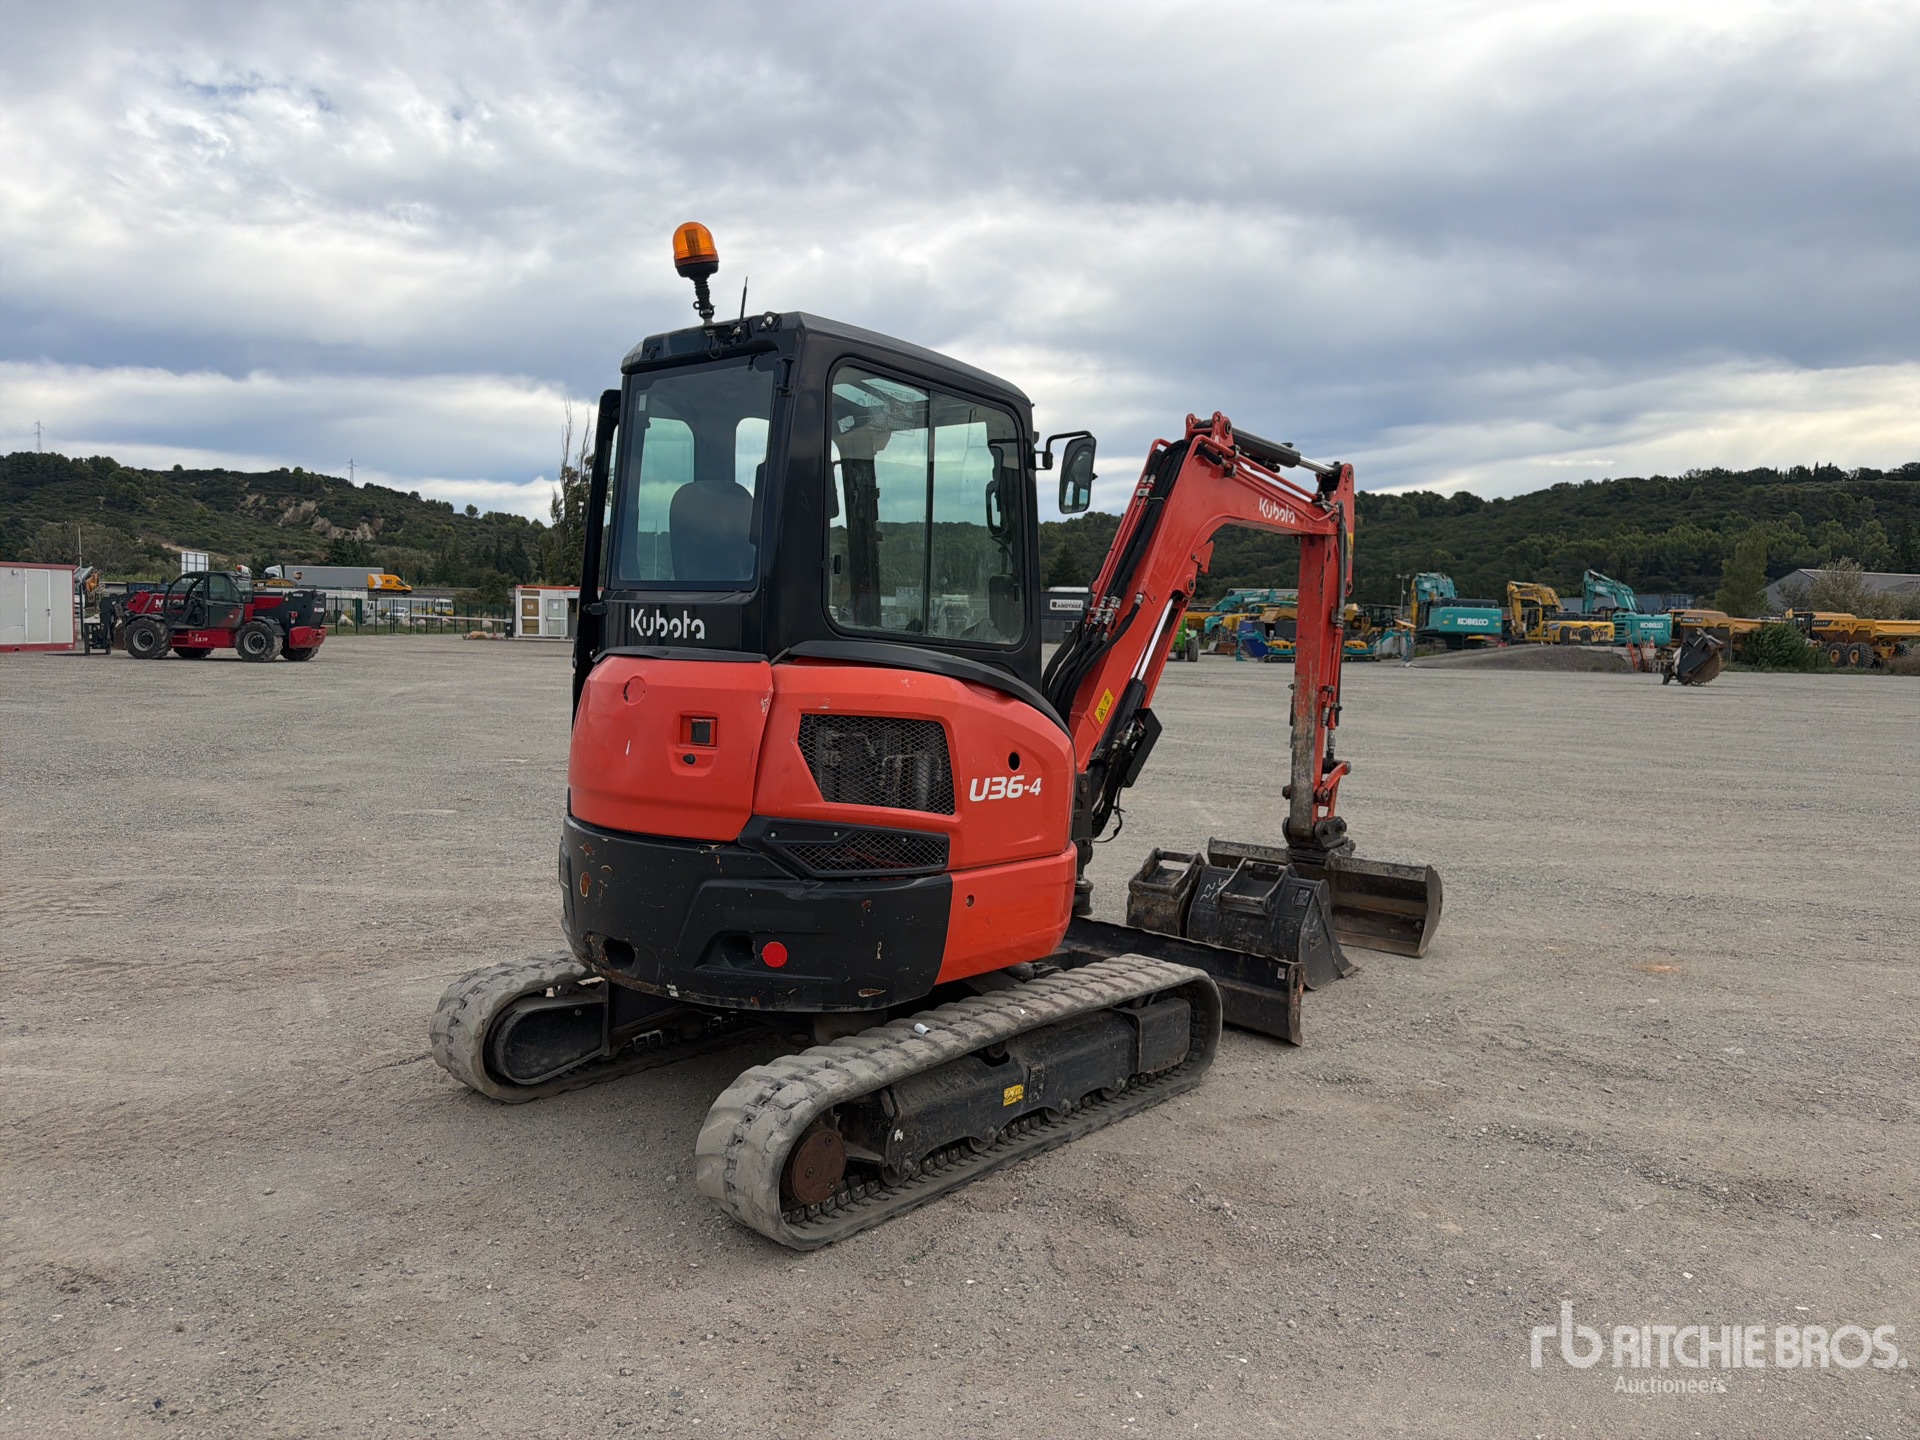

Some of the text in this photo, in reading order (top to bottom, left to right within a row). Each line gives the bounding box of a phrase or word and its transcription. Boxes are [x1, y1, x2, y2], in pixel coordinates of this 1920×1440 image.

[1259, 497, 1296, 525] Kubota
[630, 608, 706, 640] Kubota
[1457, 617, 1489, 627] KOBELCO
[1640, 621, 1664, 629] KOBELCO
[969, 775, 1042, 802] U36-4
